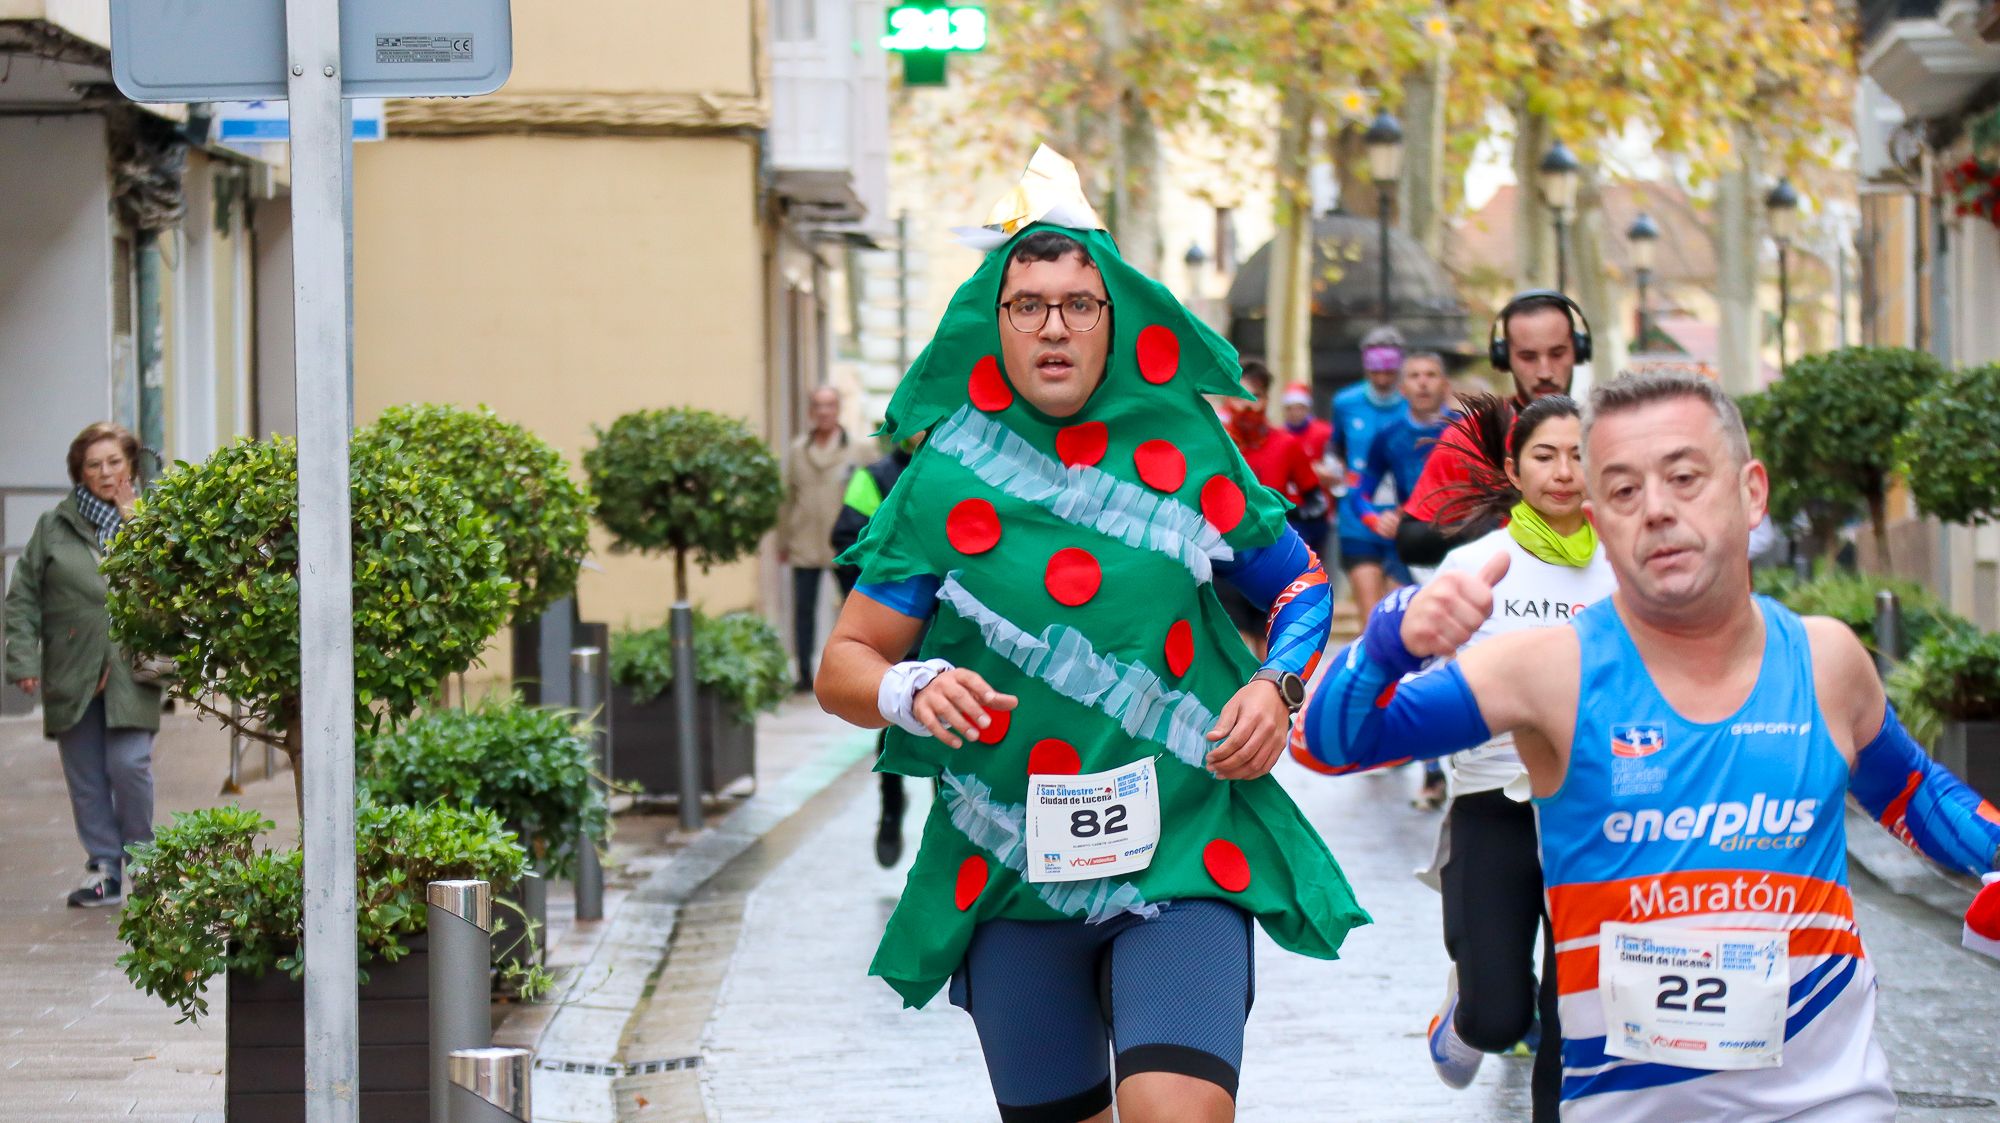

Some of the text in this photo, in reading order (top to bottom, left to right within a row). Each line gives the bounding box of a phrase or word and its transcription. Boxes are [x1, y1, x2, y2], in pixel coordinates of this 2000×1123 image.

[1040, 794, 1112, 805] Ciudad de Lucena
[1041, 787, 1055, 796] San
[1056, 787, 1094, 796] Silvestre
[1070, 804, 1128, 838] 82
[1602, 793, 1817, 846] enerplus
[1124, 842, 1154, 857] enerplus
[1629, 873, 1797, 919] Maratón
[1656, 975, 1727, 1013] 22
